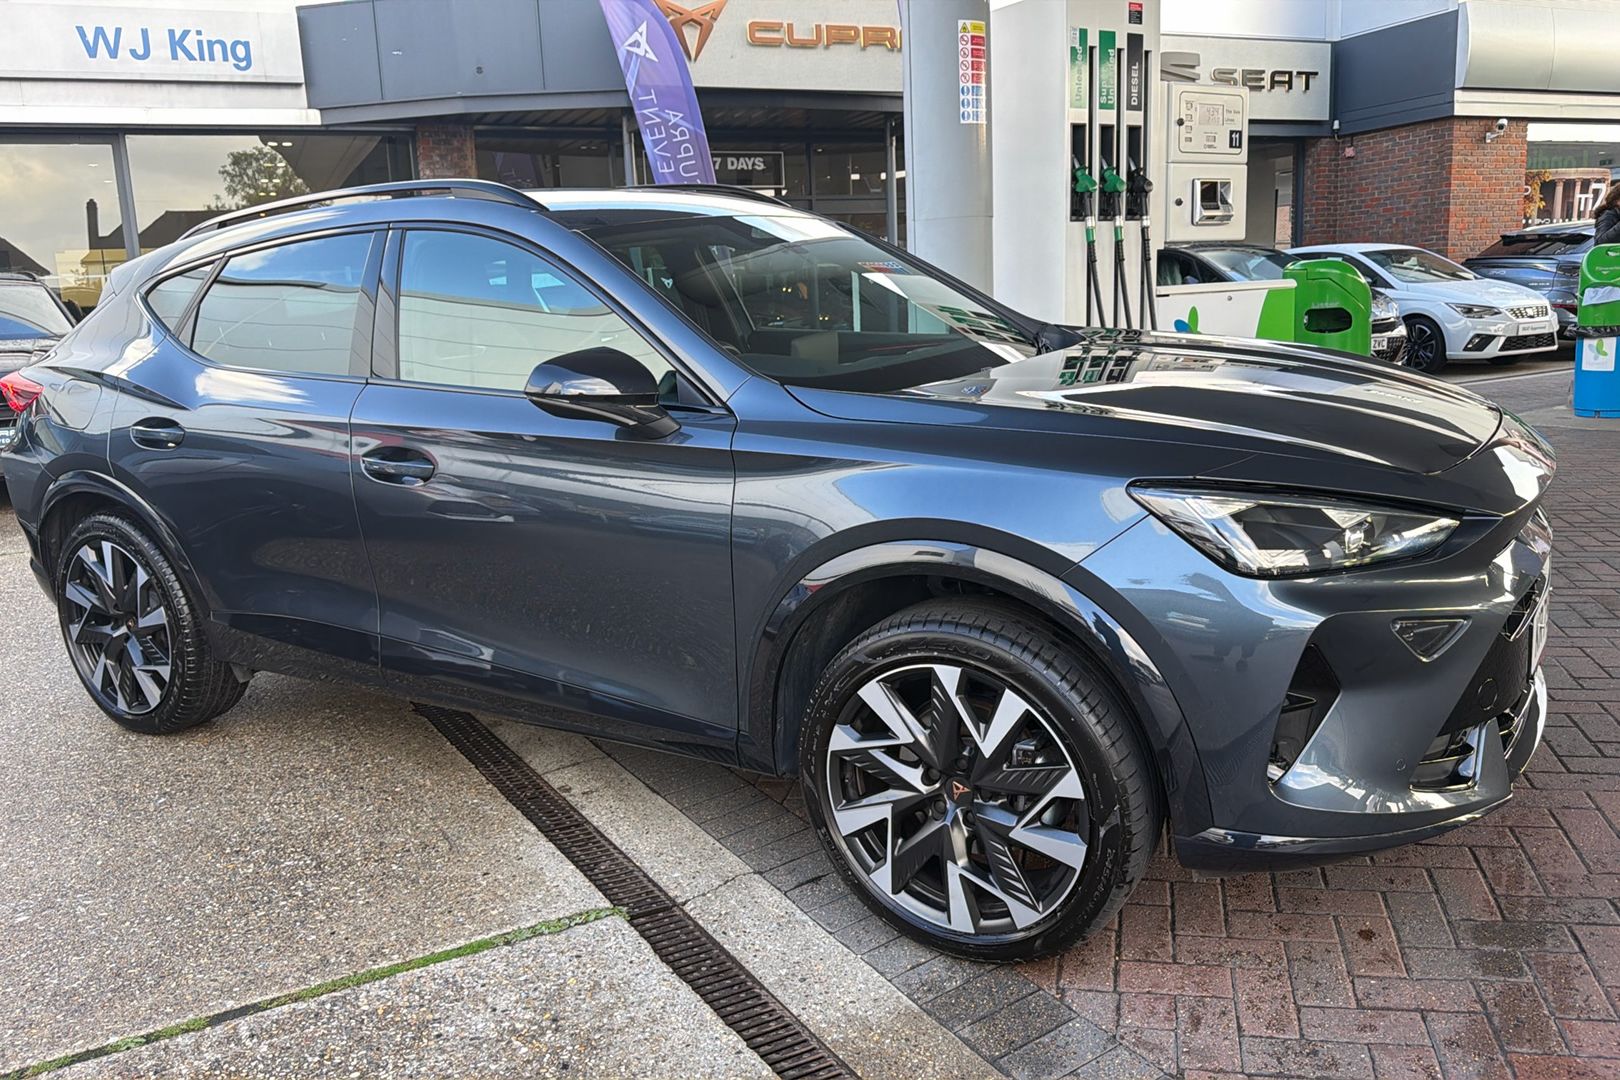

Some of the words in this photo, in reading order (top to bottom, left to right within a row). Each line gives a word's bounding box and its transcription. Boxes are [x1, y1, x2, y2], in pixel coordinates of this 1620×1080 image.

[748, 21, 901, 48] CUPR
[75, 26, 122, 59] W
[129, 28, 150, 60] J
[167, 29, 252, 71] King
[1107, 49, 1115, 104] Unlded
[1131, 62, 1139, 106] DIESEL
[1212, 68, 1319, 91] SEAT
[1231, 132, 1240, 147] 11
[713, 157, 722, 170] 7
[727, 157, 765, 170] DAYS
